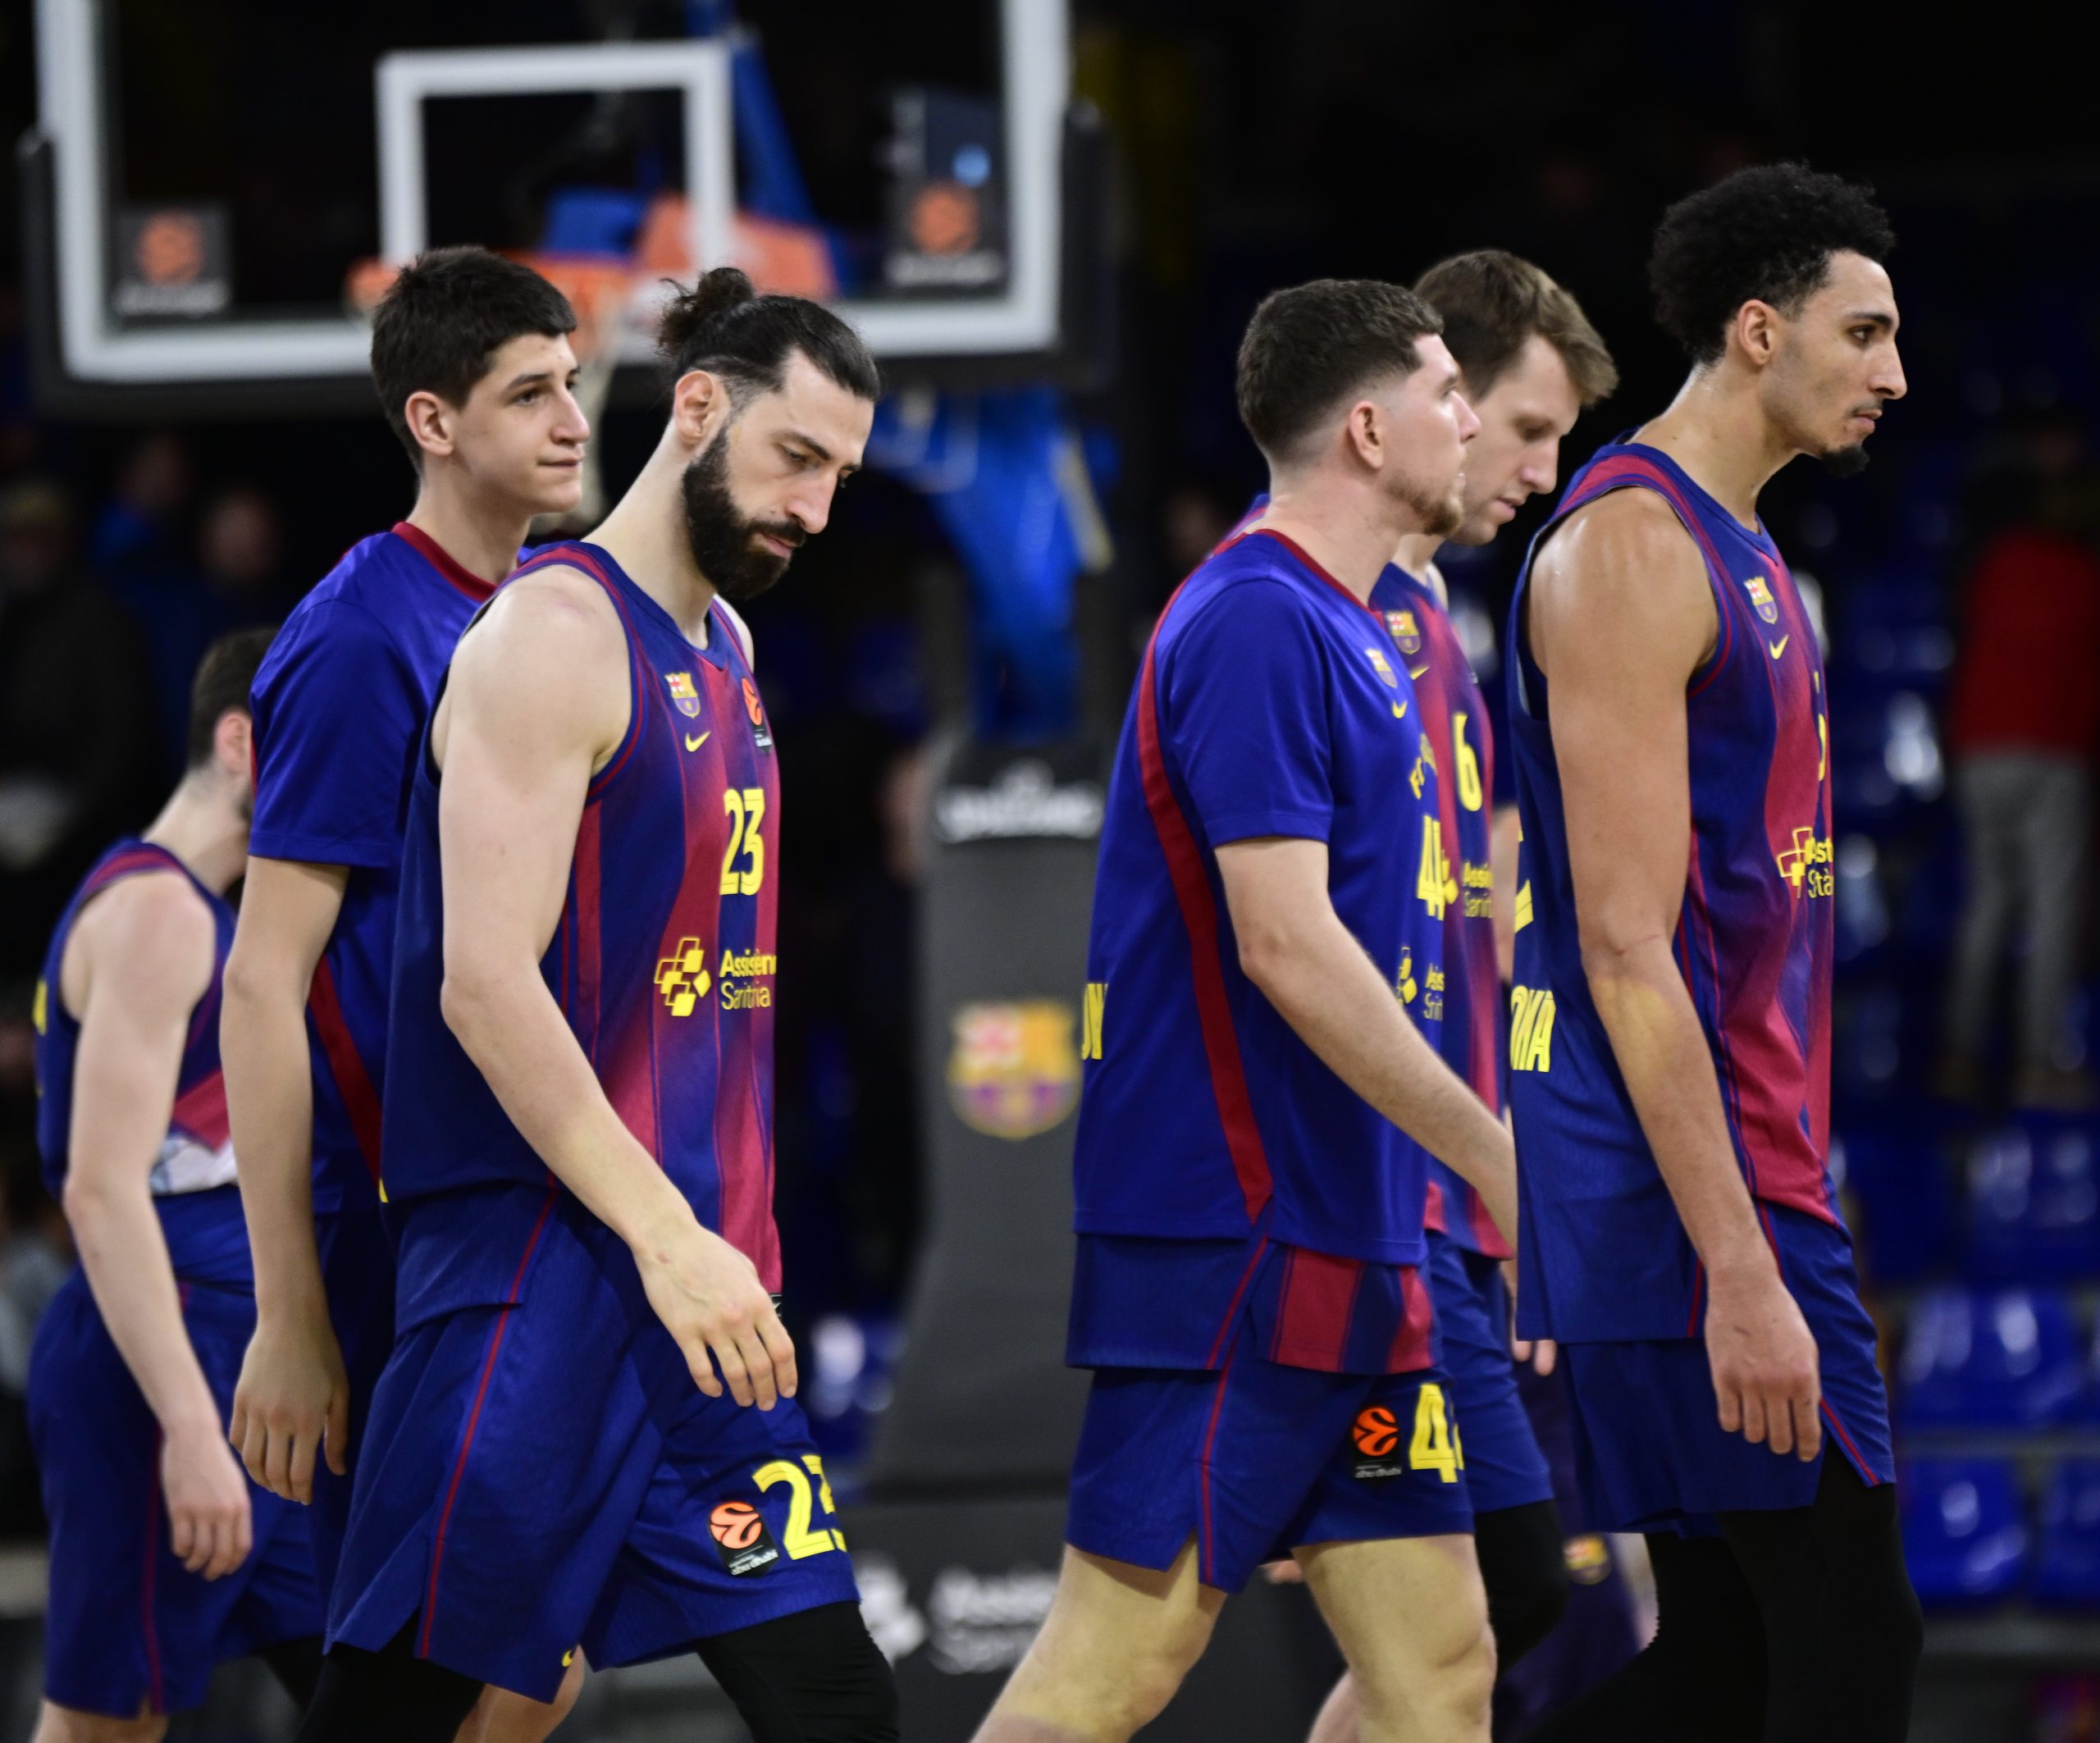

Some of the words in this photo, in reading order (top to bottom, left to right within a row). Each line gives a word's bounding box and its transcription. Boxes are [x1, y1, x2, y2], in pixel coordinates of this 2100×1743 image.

[1453, 711, 1483, 812] 6
[719, 788, 765, 897] 23
[1408, 1381, 1465, 1484] 4
